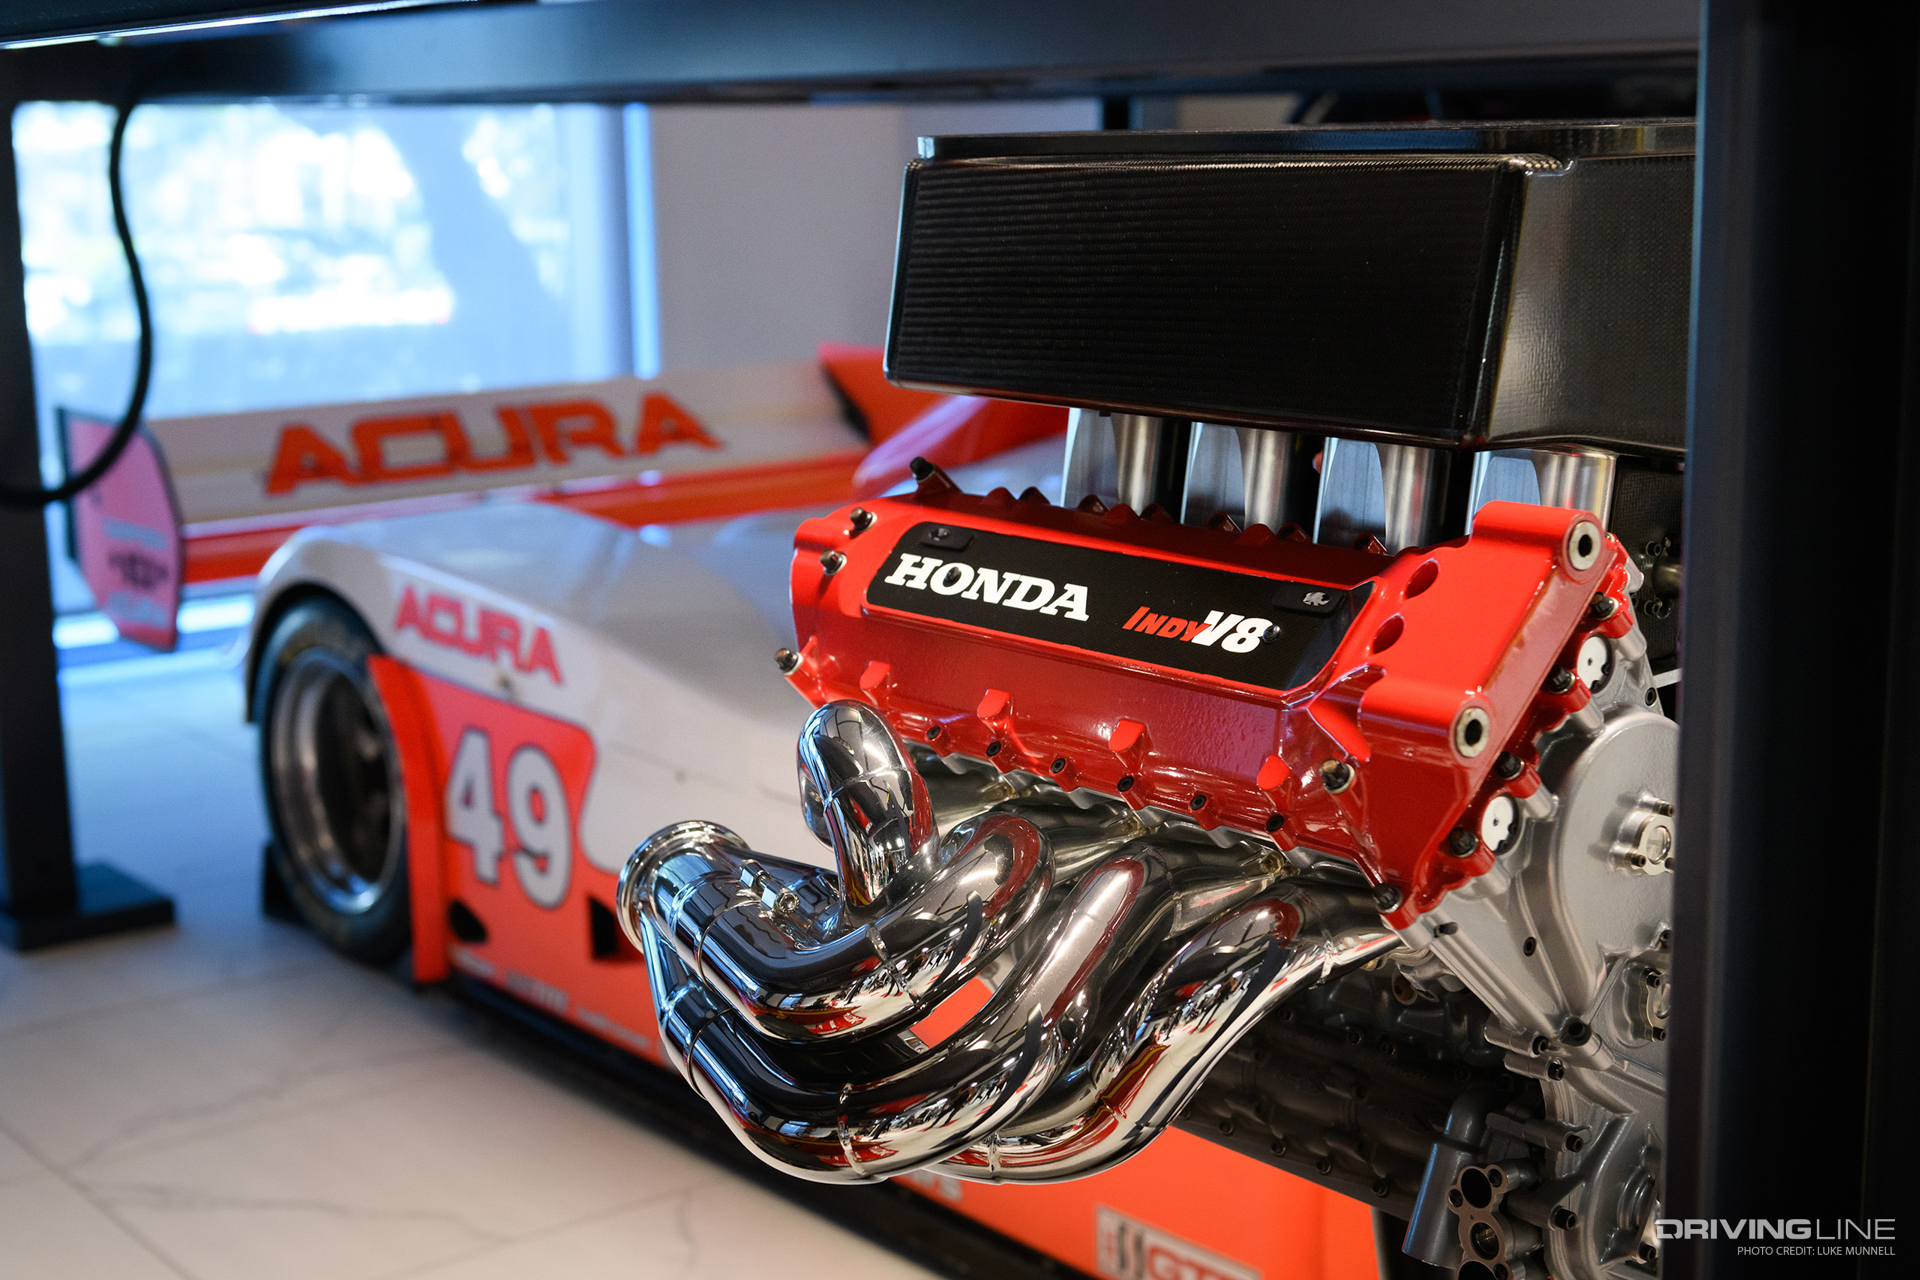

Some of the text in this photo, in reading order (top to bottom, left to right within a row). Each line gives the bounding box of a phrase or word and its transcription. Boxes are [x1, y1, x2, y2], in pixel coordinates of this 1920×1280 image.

[264, 391, 724, 496] ACURA
[395, 585, 564, 686] ACURA
[884, 552, 1090, 622] HONDA
[444, 725, 573, 910] 49
